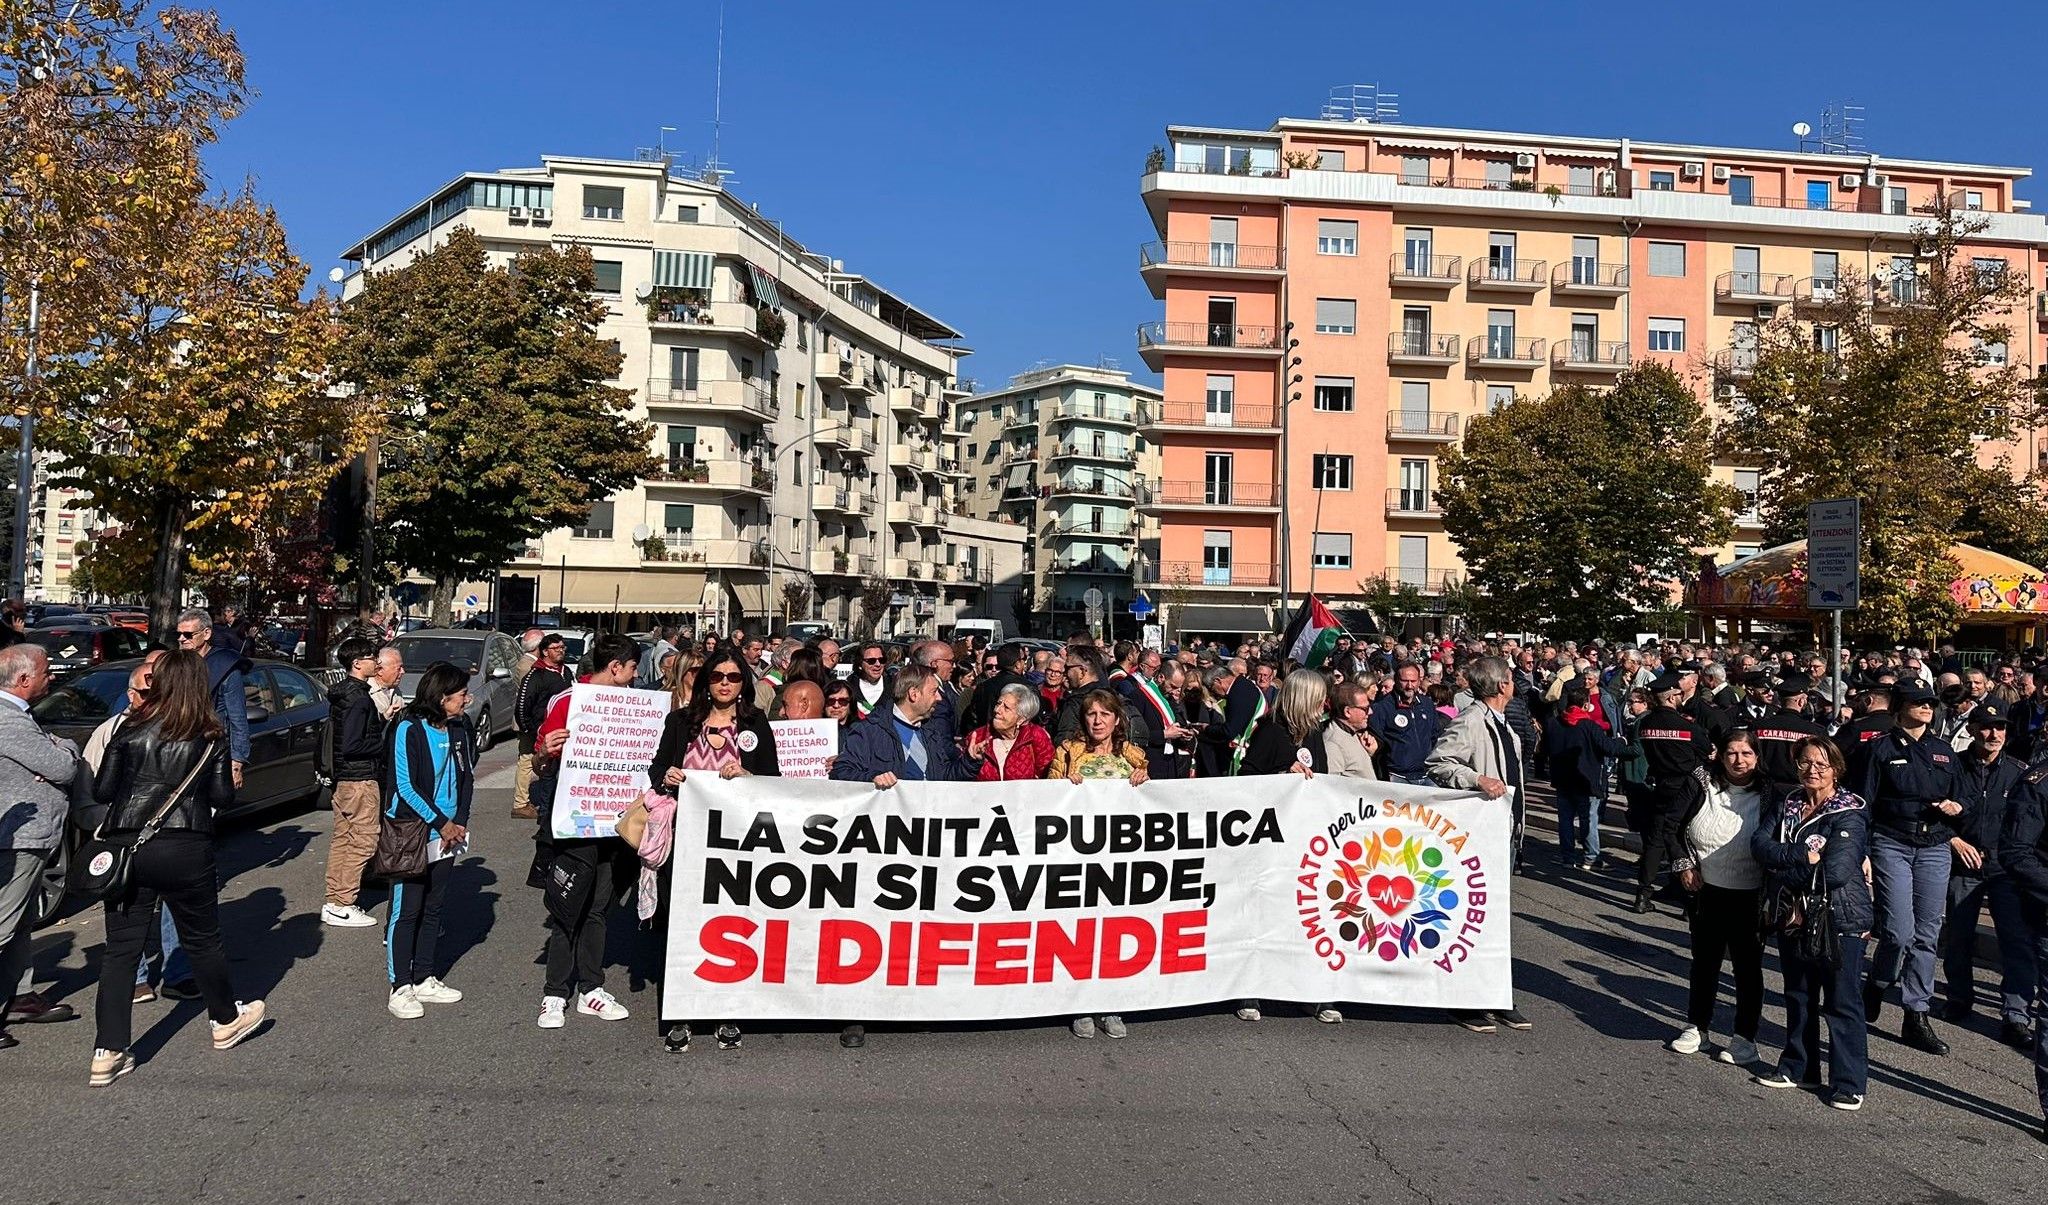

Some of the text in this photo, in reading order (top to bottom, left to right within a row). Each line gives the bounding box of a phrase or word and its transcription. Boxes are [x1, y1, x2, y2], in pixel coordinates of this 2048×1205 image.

[1811, 528, 1853, 538] ATTENZIONE
[595, 693, 652, 706] SIAMO DELLA
[581, 704, 663, 719] VALLE DELL'ESARO
[578, 724, 658, 738] OGGI, PURTROPPO
[787, 727, 815, 736] DELLA
[1641, 729, 1680, 737] CARABINIERI
[576, 736, 656, 750] NON SI CHIAMA PIÙ
[776, 738, 829, 748] DELL'ESARO
[572, 748, 654, 761] VALLE DELL'ESARO
[566, 760, 577, 769] MA
[579, 761, 601, 770] VALLE
[603, 762, 625, 772] DELLE
[570, 786, 643, 798] SENZA SANITÀ
[580, 800, 591, 810] SI
[706, 805, 1285, 858] LA SANITÀ PUBBLICA
[703, 857, 1216, 913] NON SI SVENDE,
[1297, 798, 1487, 974] COMITATO per la SANITÀ PUBBLICA
[693, 909, 1208, 986] SI DIFENDE
